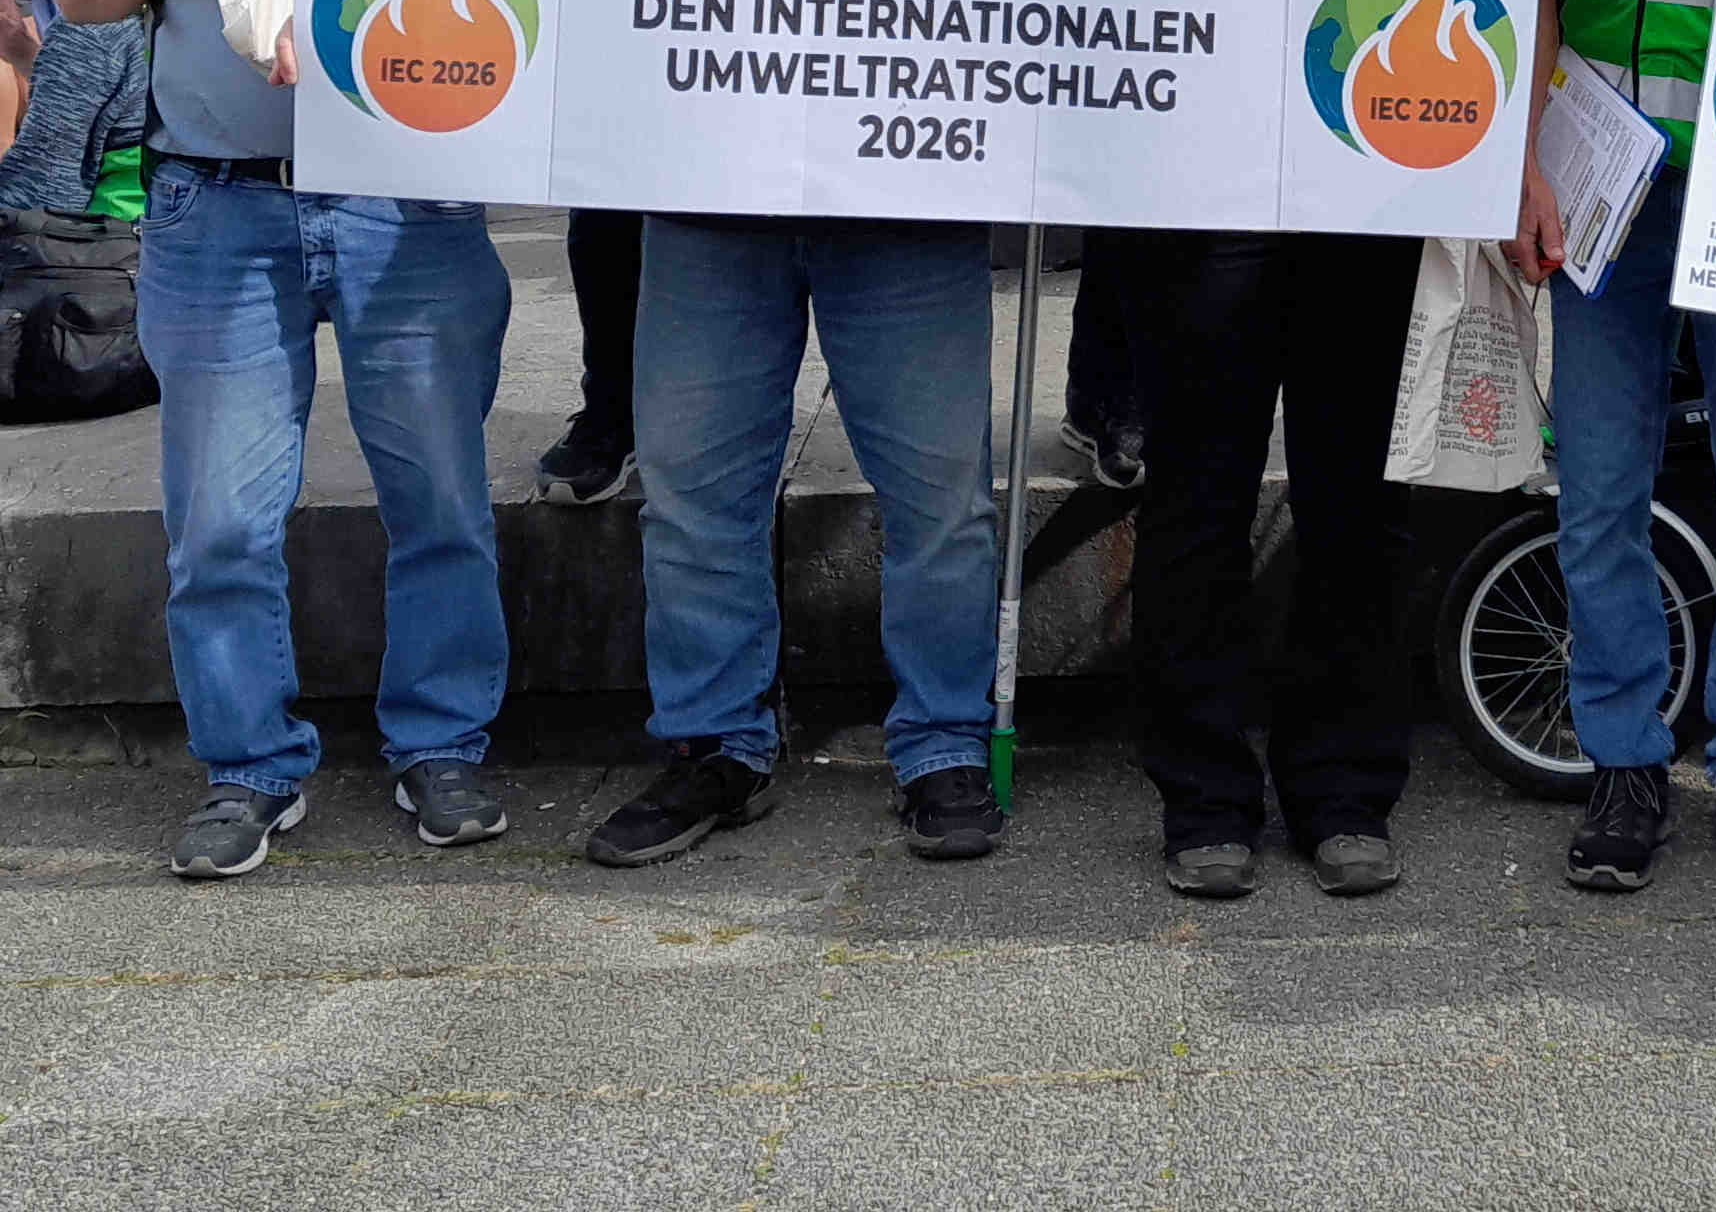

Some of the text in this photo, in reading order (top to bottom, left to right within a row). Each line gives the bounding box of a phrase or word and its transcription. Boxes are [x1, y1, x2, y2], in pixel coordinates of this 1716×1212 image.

[380, 57, 497, 87] IEC 2026
[666, 47, 1177, 112] UMWELTRATSCHLAG
[1370, 96, 1479, 125] IEC 2026
[858, 114, 987, 162] 2026!
